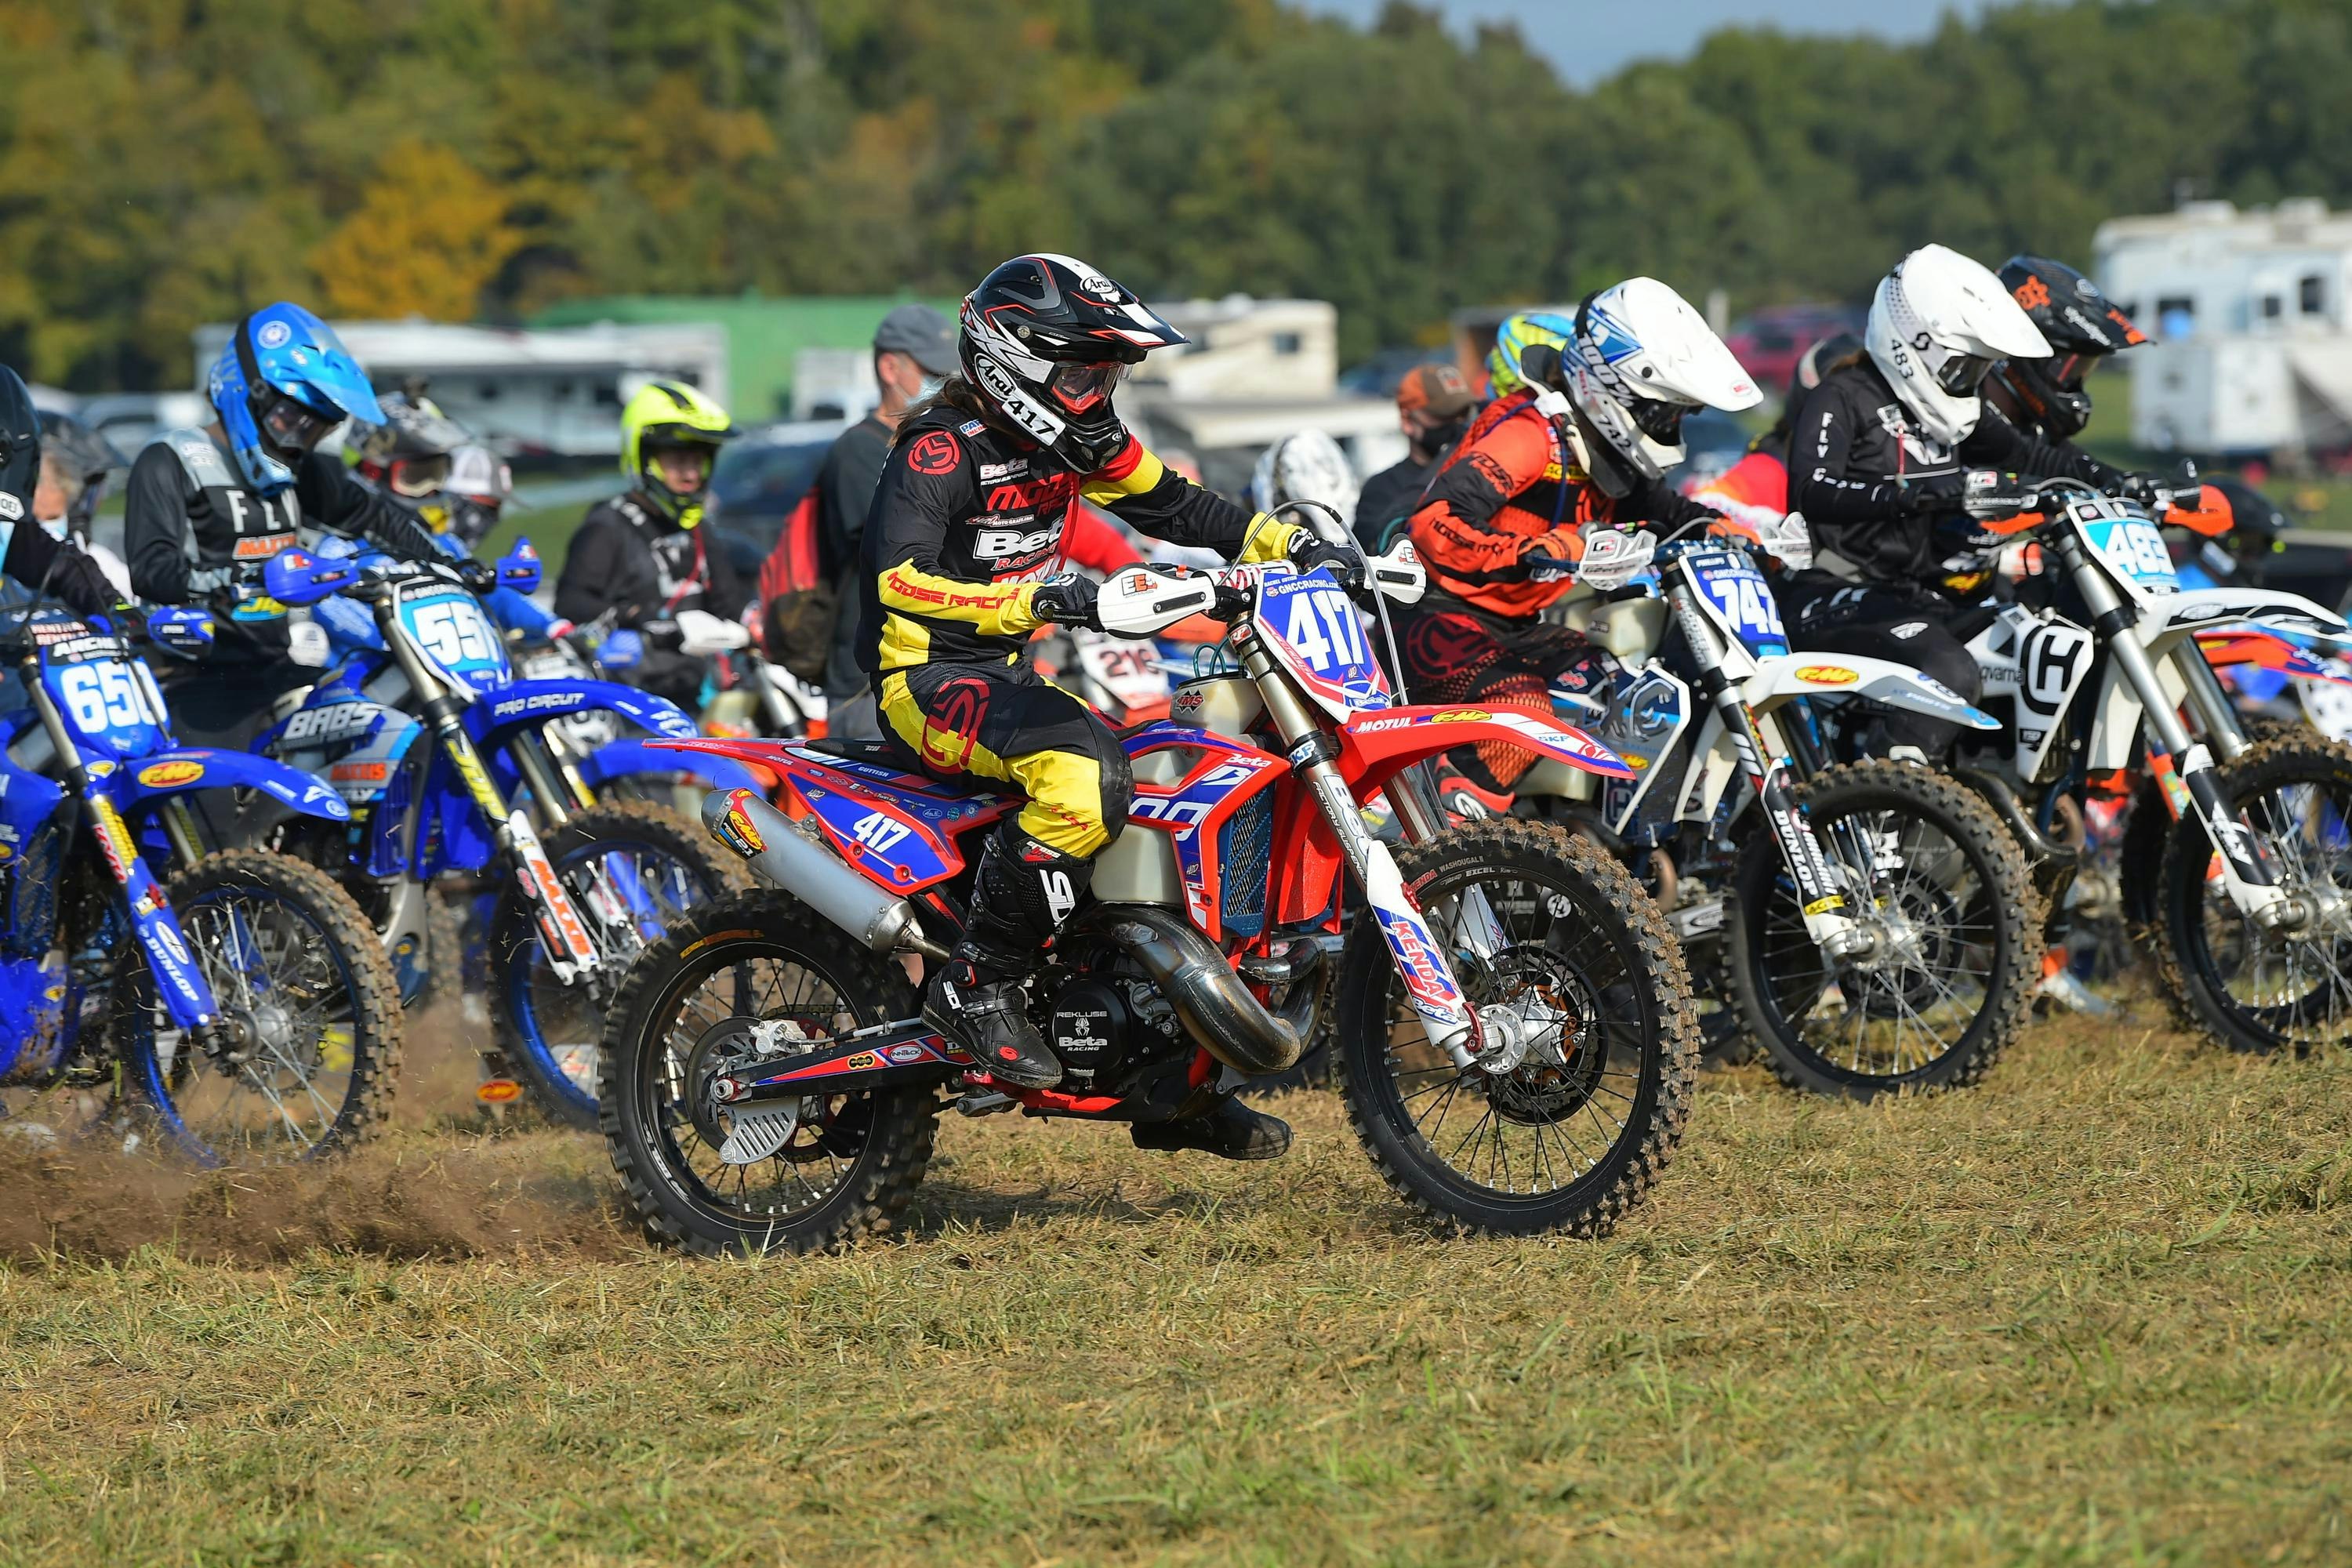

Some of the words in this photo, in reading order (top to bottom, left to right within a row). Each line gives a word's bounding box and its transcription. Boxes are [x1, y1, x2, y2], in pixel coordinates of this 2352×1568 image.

[1089, 278, 1110, 291] Arai
[1890, 339, 1914, 379] 483
[978, 361, 1015, 397] Arai
[1007, 399, 1056, 436] 417
[1598, 419, 1632, 451] 742
[980, 458, 1029, 481] Beta
[974, 514, 1065, 557] Bet
[2104, 522, 2177, 577] 483
[994, 543, 1058, 571] RACING
[1709, 578, 1786, 636] 742
[1284, 590, 1366, 673] 417
[1796, 666, 1859, 685] FMF
[1977, 664, 2026, 688] qvarna
[60, 660, 169, 734] 650
[494, 699, 526, 717] PRO
[527, 692, 585, 711] CIRCUIT
[1177, 695, 1204, 706] IMS
[282, 701, 386, 740] BABS
[1355, 716, 1412, 734] MOTUL
[1431, 709, 1493, 723] FMF
[1538, 735, 1571, 743] SKF
[766, 755, 794, 765] MOTUL
[858, 766, 890, 778] CUTTISH
[1225, 753, 1273, 768] Beta
[728, 811, 763, 849] FMF
[1323, 775, 1373, 858] Bet
[853, 811, 912, 853] 417
[1312, 781, 1339, 828] FACTORY
[1335, 827, 1368, 885] SUSPENSI
[1439, 855, 1480, 873] WASHOUGAL
[1773, 809, 1819, 897] DUNLOP
[1465, 866, 1496, 877] EXCEL
[146, 935, 199, 1002] DUNLOP
[1390, 921, 1445, 997] KENDA
[1056, 1010, 1108, 1018] REKLUSE
[1413, 996, 1457, 1024] Beta
[1058, 1036, 1108, 1048] Beta
